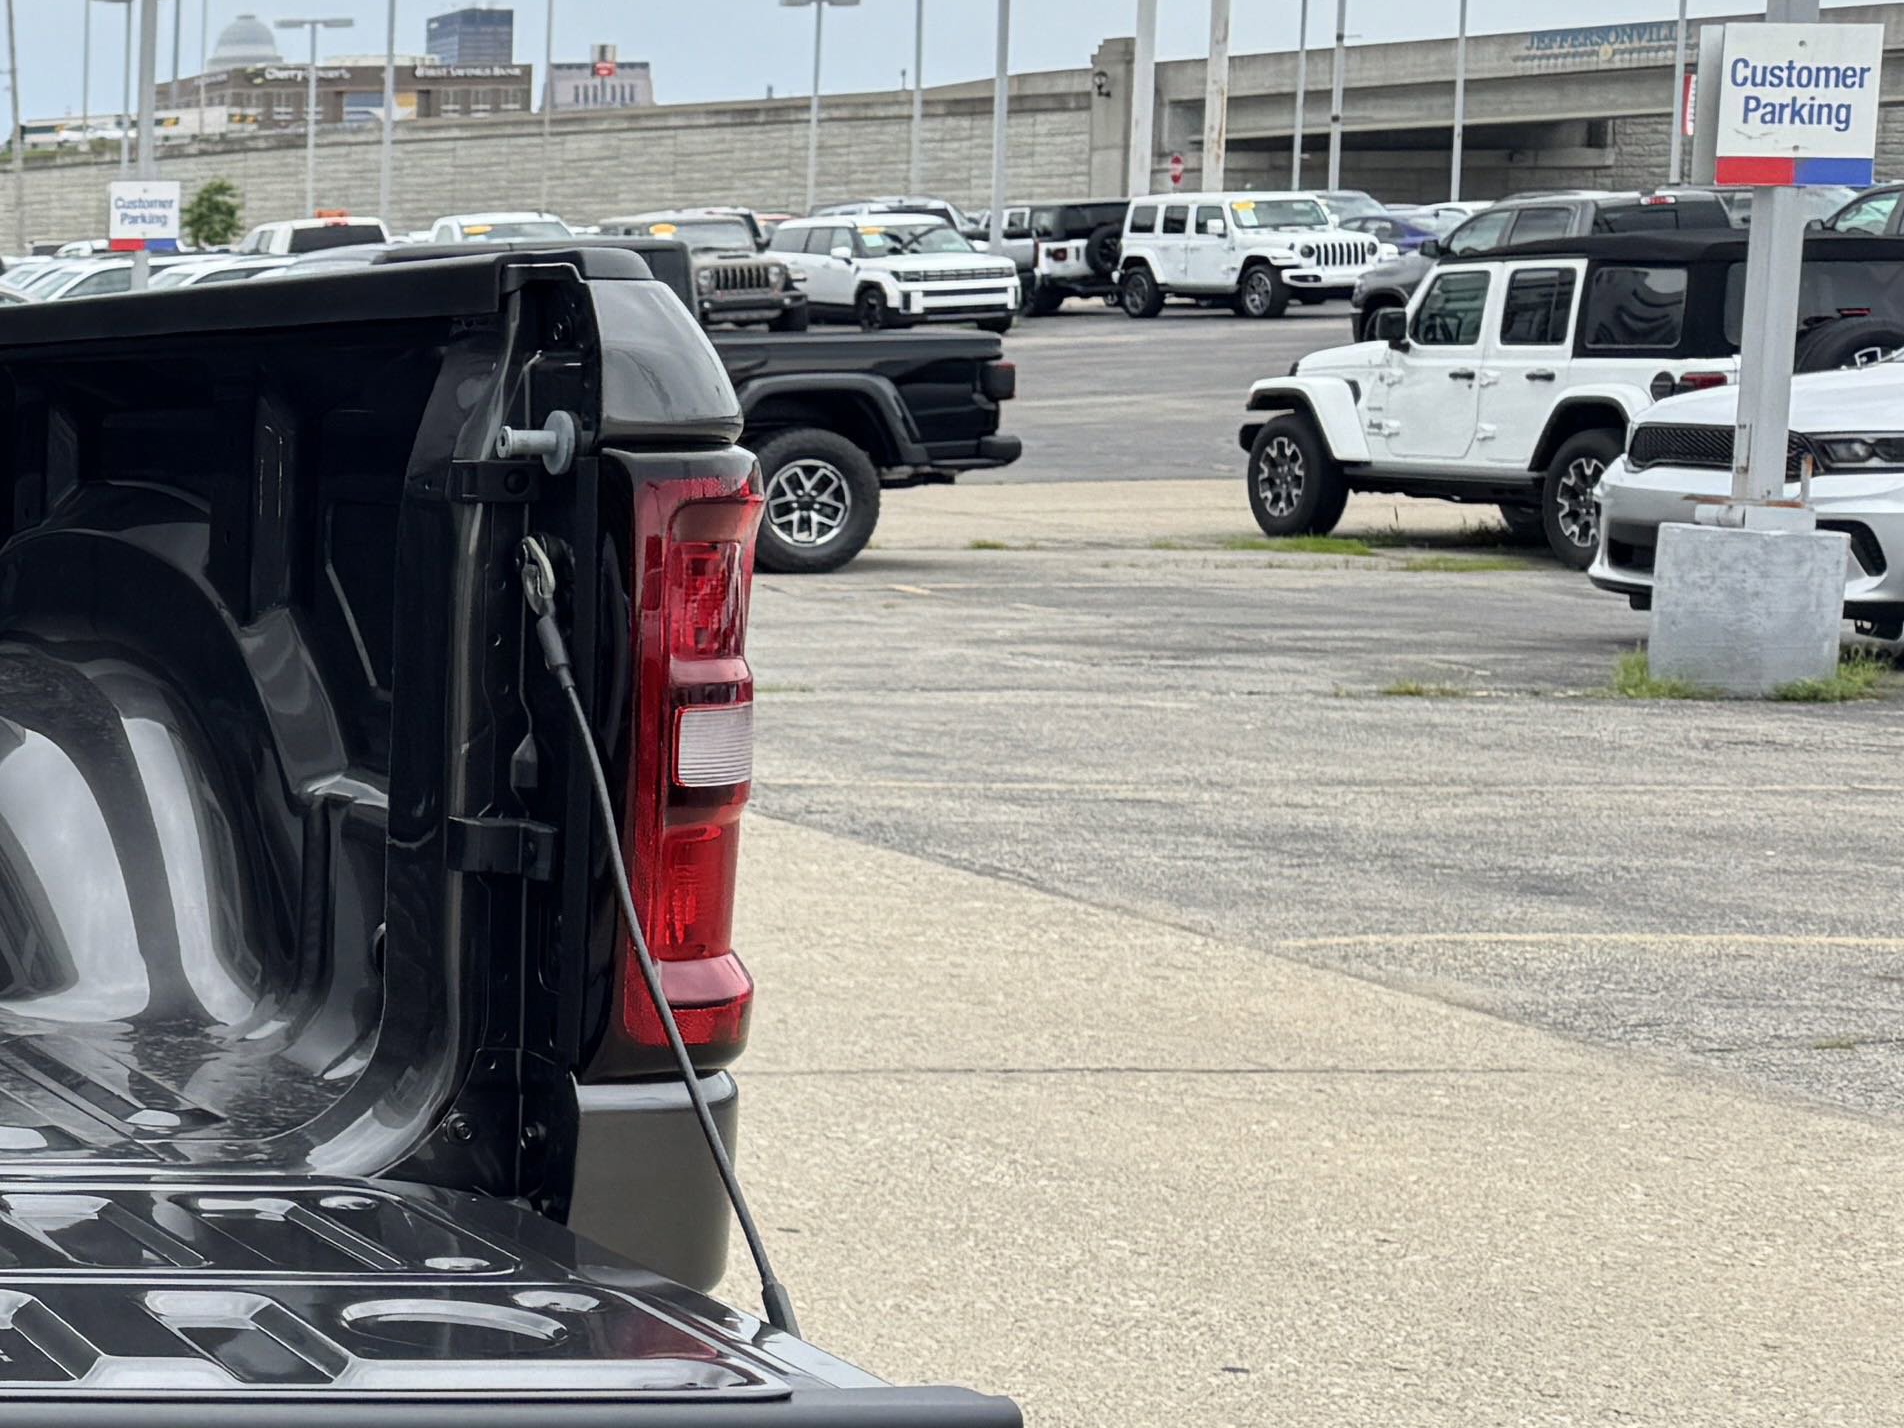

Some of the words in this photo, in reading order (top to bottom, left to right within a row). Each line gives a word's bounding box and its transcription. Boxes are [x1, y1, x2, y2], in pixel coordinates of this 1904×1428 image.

[1730, 57, 1871, 88] Customer
[1742, 95, 1852, 132] Parking
[114, 197, 173, 210] Customer
[120, 213, 168, 227] Parking
